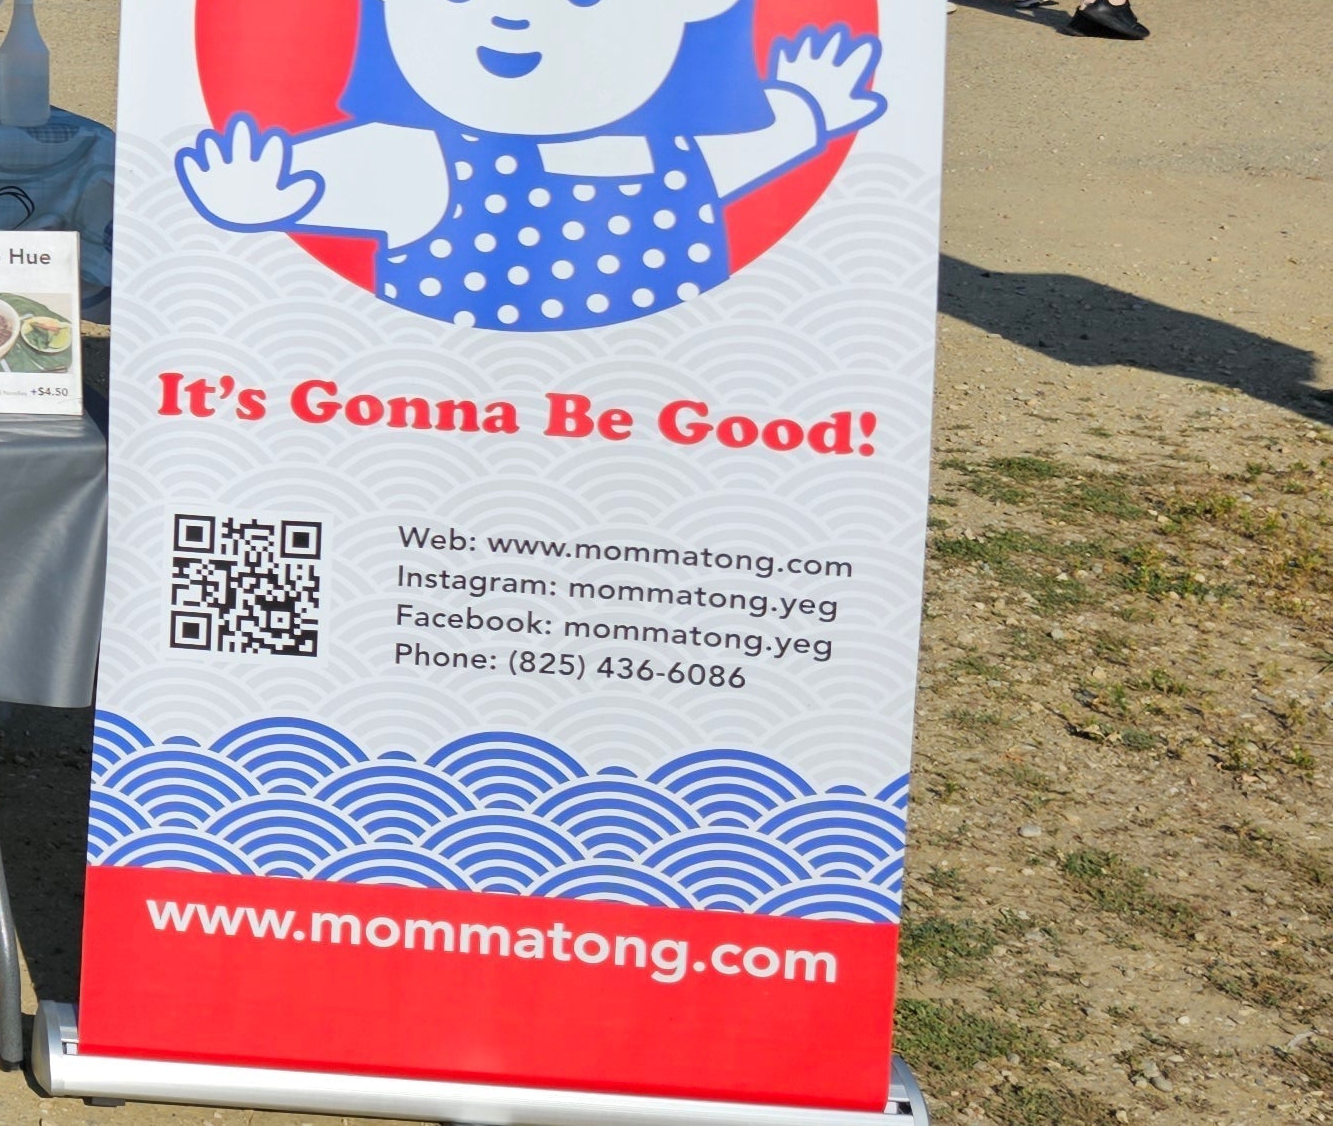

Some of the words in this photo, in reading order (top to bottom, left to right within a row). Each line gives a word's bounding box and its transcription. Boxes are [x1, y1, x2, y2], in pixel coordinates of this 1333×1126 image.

[9, 248, 52, 265] Hue
[157, 372, 268, 422] It's
[290, 379, 520, 436] Gonna
[545, 392, 633, 443] Be
[658, 400, 877, 458] Good!
[398, 525, 477, 554] Web:
[486, 532, 854, 580] www.mommatong.com
[397, 565, 557, 604] Instagram:
[568, 578, 840, 624] mommatong.yeg
[396, 604, 553, 639] Facebook:
[563, 616, 835, 663] mommatong.yeg
[394, 643, 497, 673] Phone:
[508, 647, 587, 683] (825)
[596, 655, 747, 691] 436-6086
[146, 898, 839, 985] www.mommatong.com
